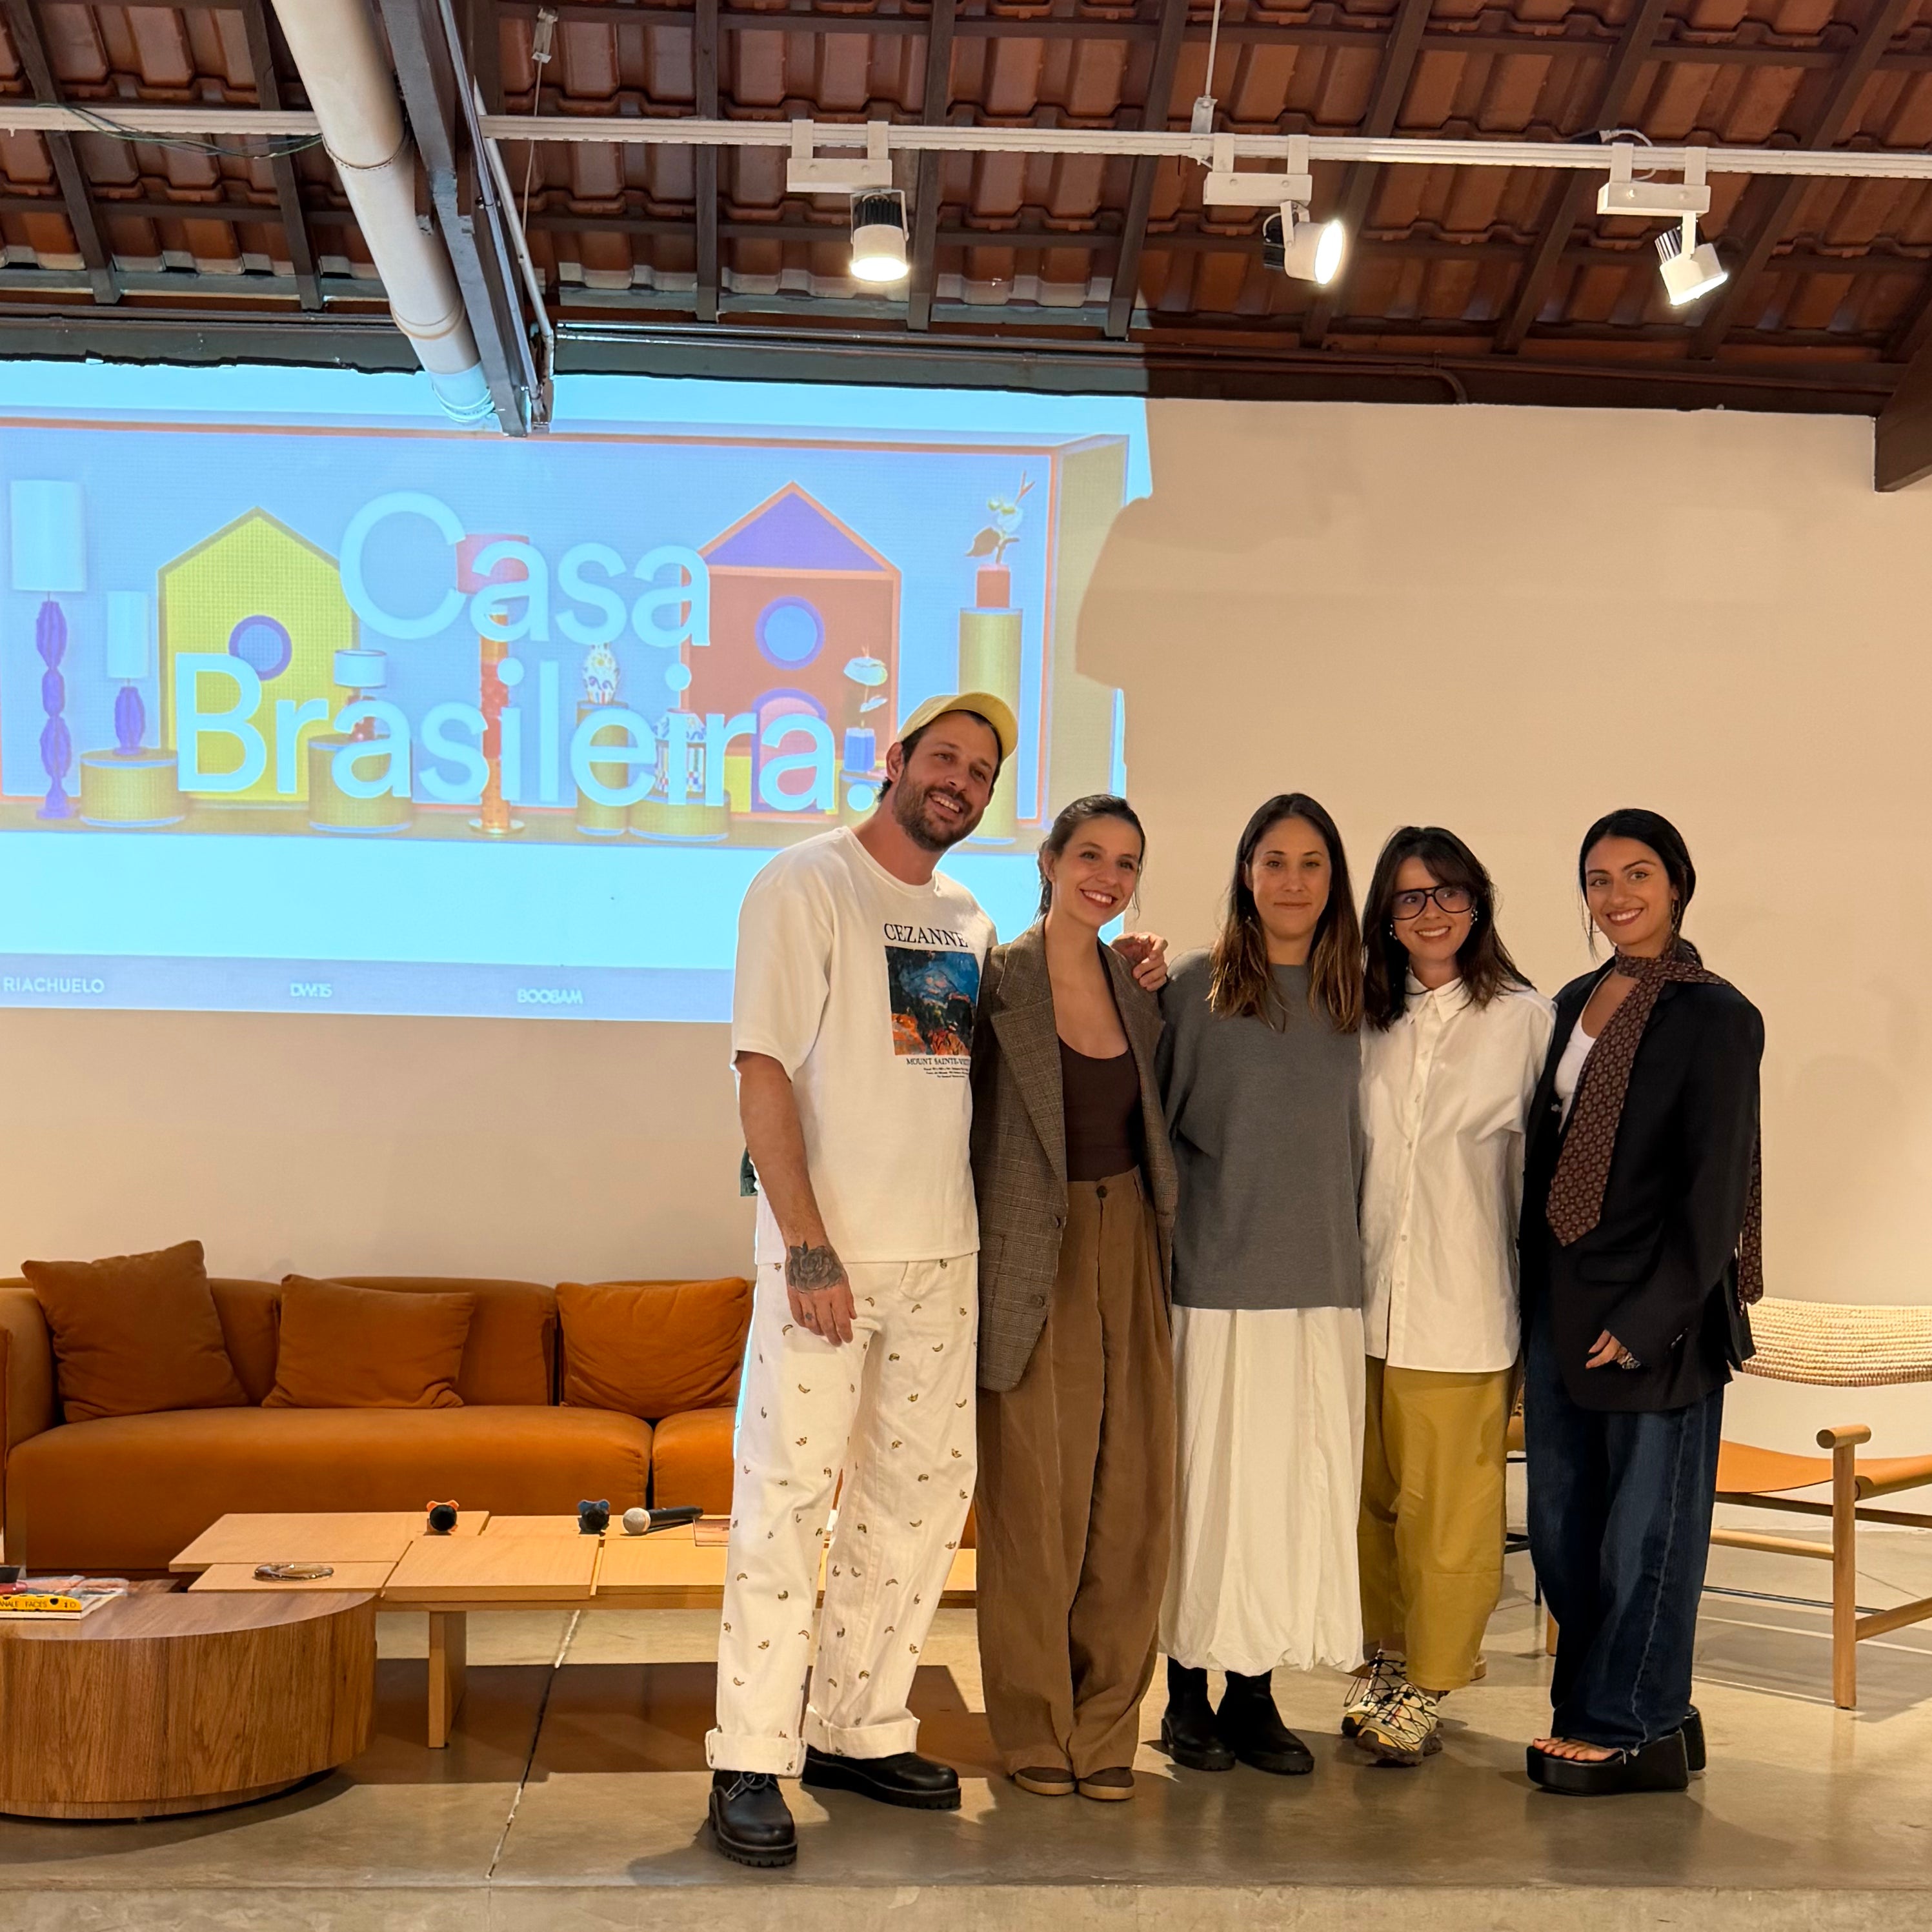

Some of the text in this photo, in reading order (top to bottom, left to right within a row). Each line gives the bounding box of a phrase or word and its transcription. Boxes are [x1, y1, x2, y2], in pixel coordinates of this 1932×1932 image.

[339, 490, 710, 647] Casa
[176, 652, 875, 812] Brasileira.
[884, 923, 968, 948] CEZANNE
[3, 977, 105, 994] RIACHUELO
